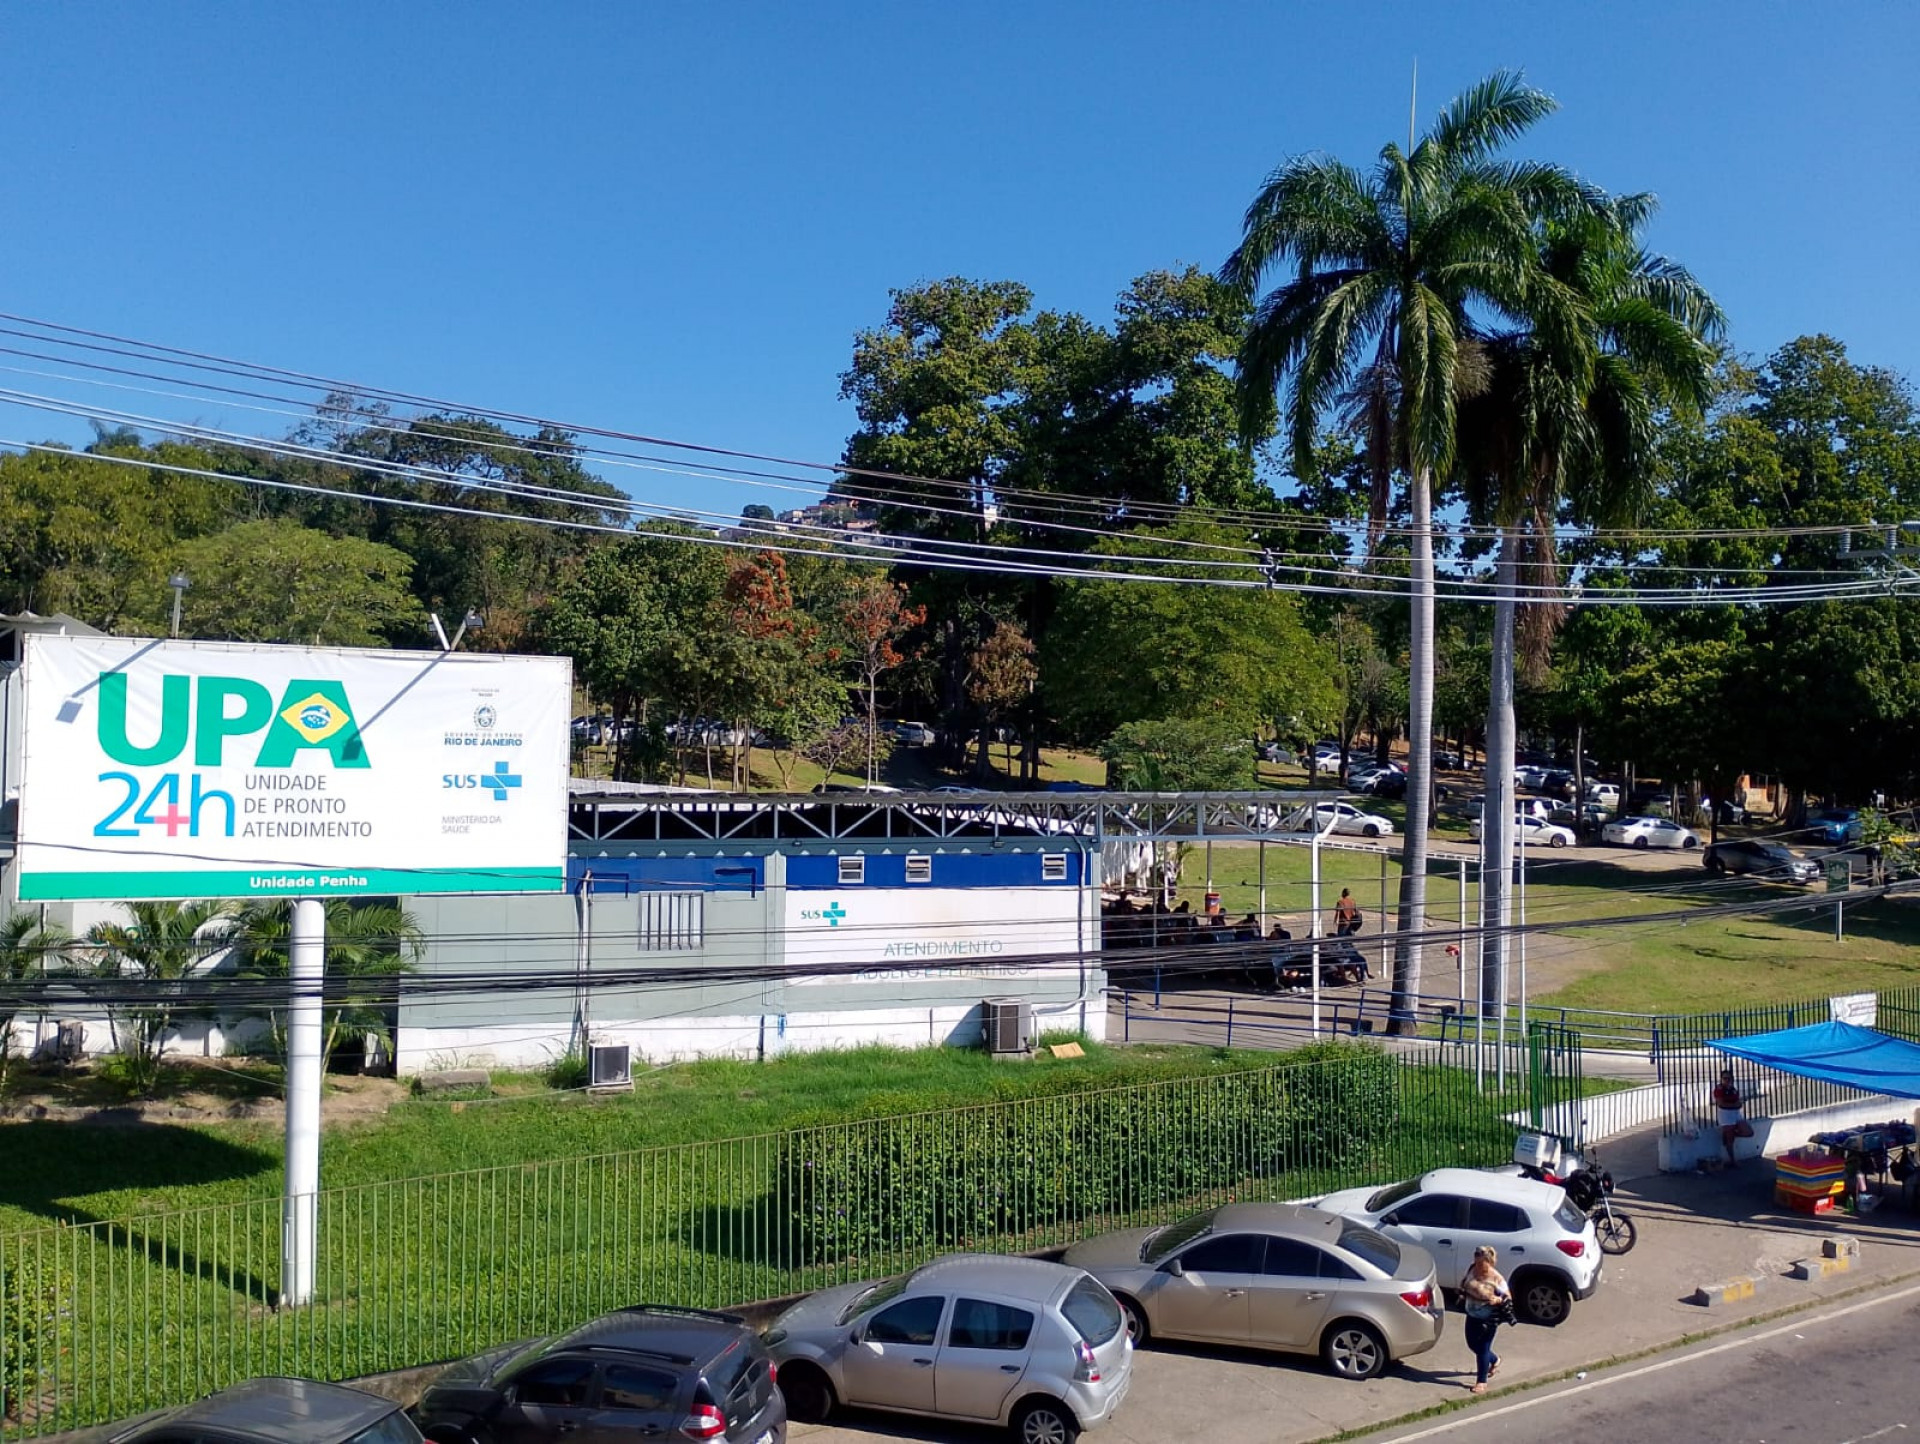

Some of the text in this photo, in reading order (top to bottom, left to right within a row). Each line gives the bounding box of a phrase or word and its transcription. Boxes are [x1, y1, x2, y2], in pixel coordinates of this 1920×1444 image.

[97, 671, 372, 769] UPA
[444, 737, 523, 747] RIO DE JANEIRO
[245, 774, 327, 791] UNIDADE
[442, 774, 478, 789] SUS
[93, 771, 235, 837] 24h
[244, 798, 346, 814] DE PRONTO
[242, 821, 372, 837] ATENDIMENTO
[250, 875, 368, 888] Unidade Penha
[801, 910, 821, 919] SUS
[883, 940, 1003, 957] ATENDIMENTO
